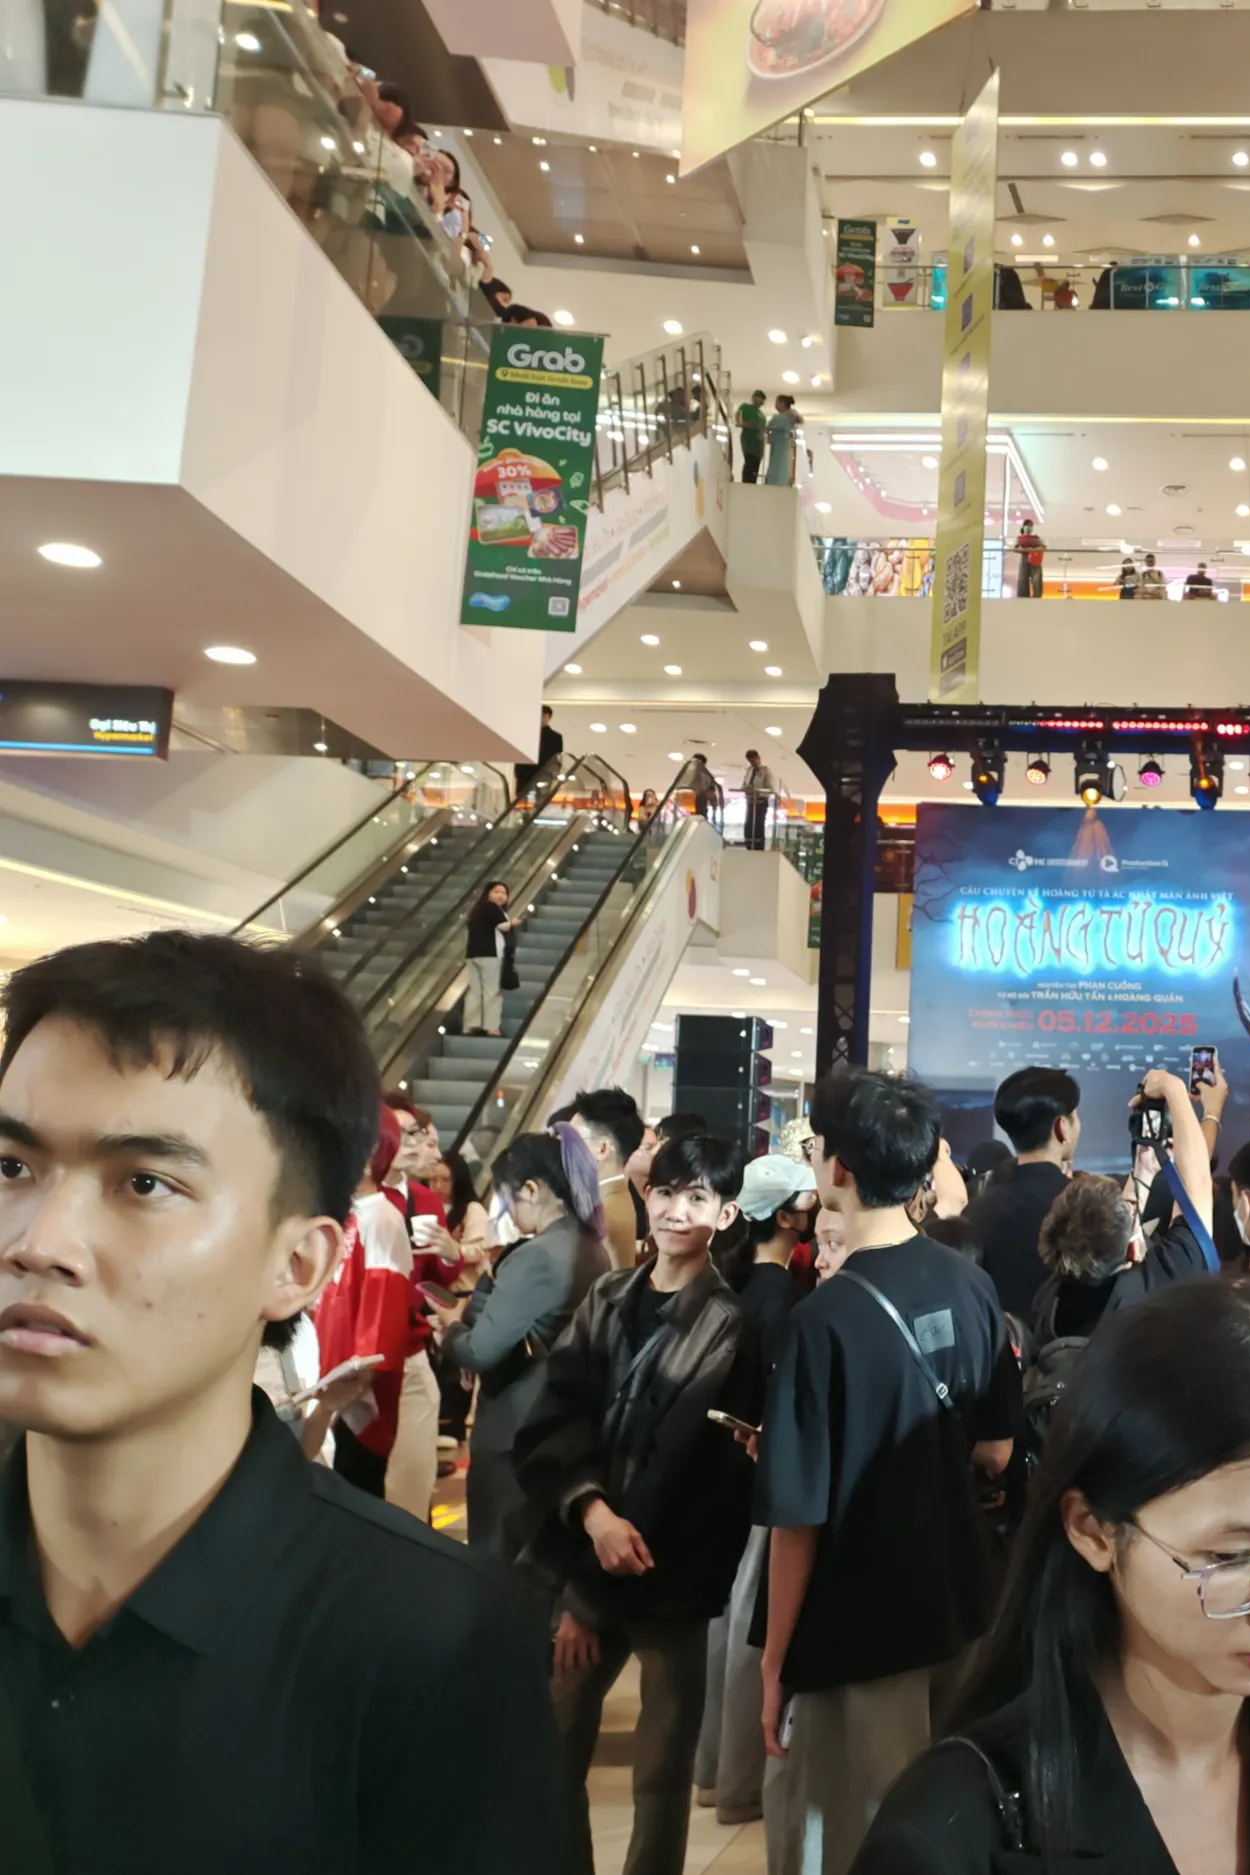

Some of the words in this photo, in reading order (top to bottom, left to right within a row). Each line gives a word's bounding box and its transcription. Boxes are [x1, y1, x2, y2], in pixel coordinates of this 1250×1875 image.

[507, 343, 585, 373] Grab
[525, 391, 540, 404] Đi
[496, 403, 523, 416] nhà
[525, 405, 560, 423] hàng
[563, 410, 581, 424] tại
[486, 419, 510, 435] SC
[513, 421, 592, 447] VivoCity
[497, 465, 532, 479] 30%
[957, 898, 1094, 975] HOÀNG
[1153, 902, 1230, 969] QUỶ
[1037, 1009, 1198, 1036] 05.12.2025
